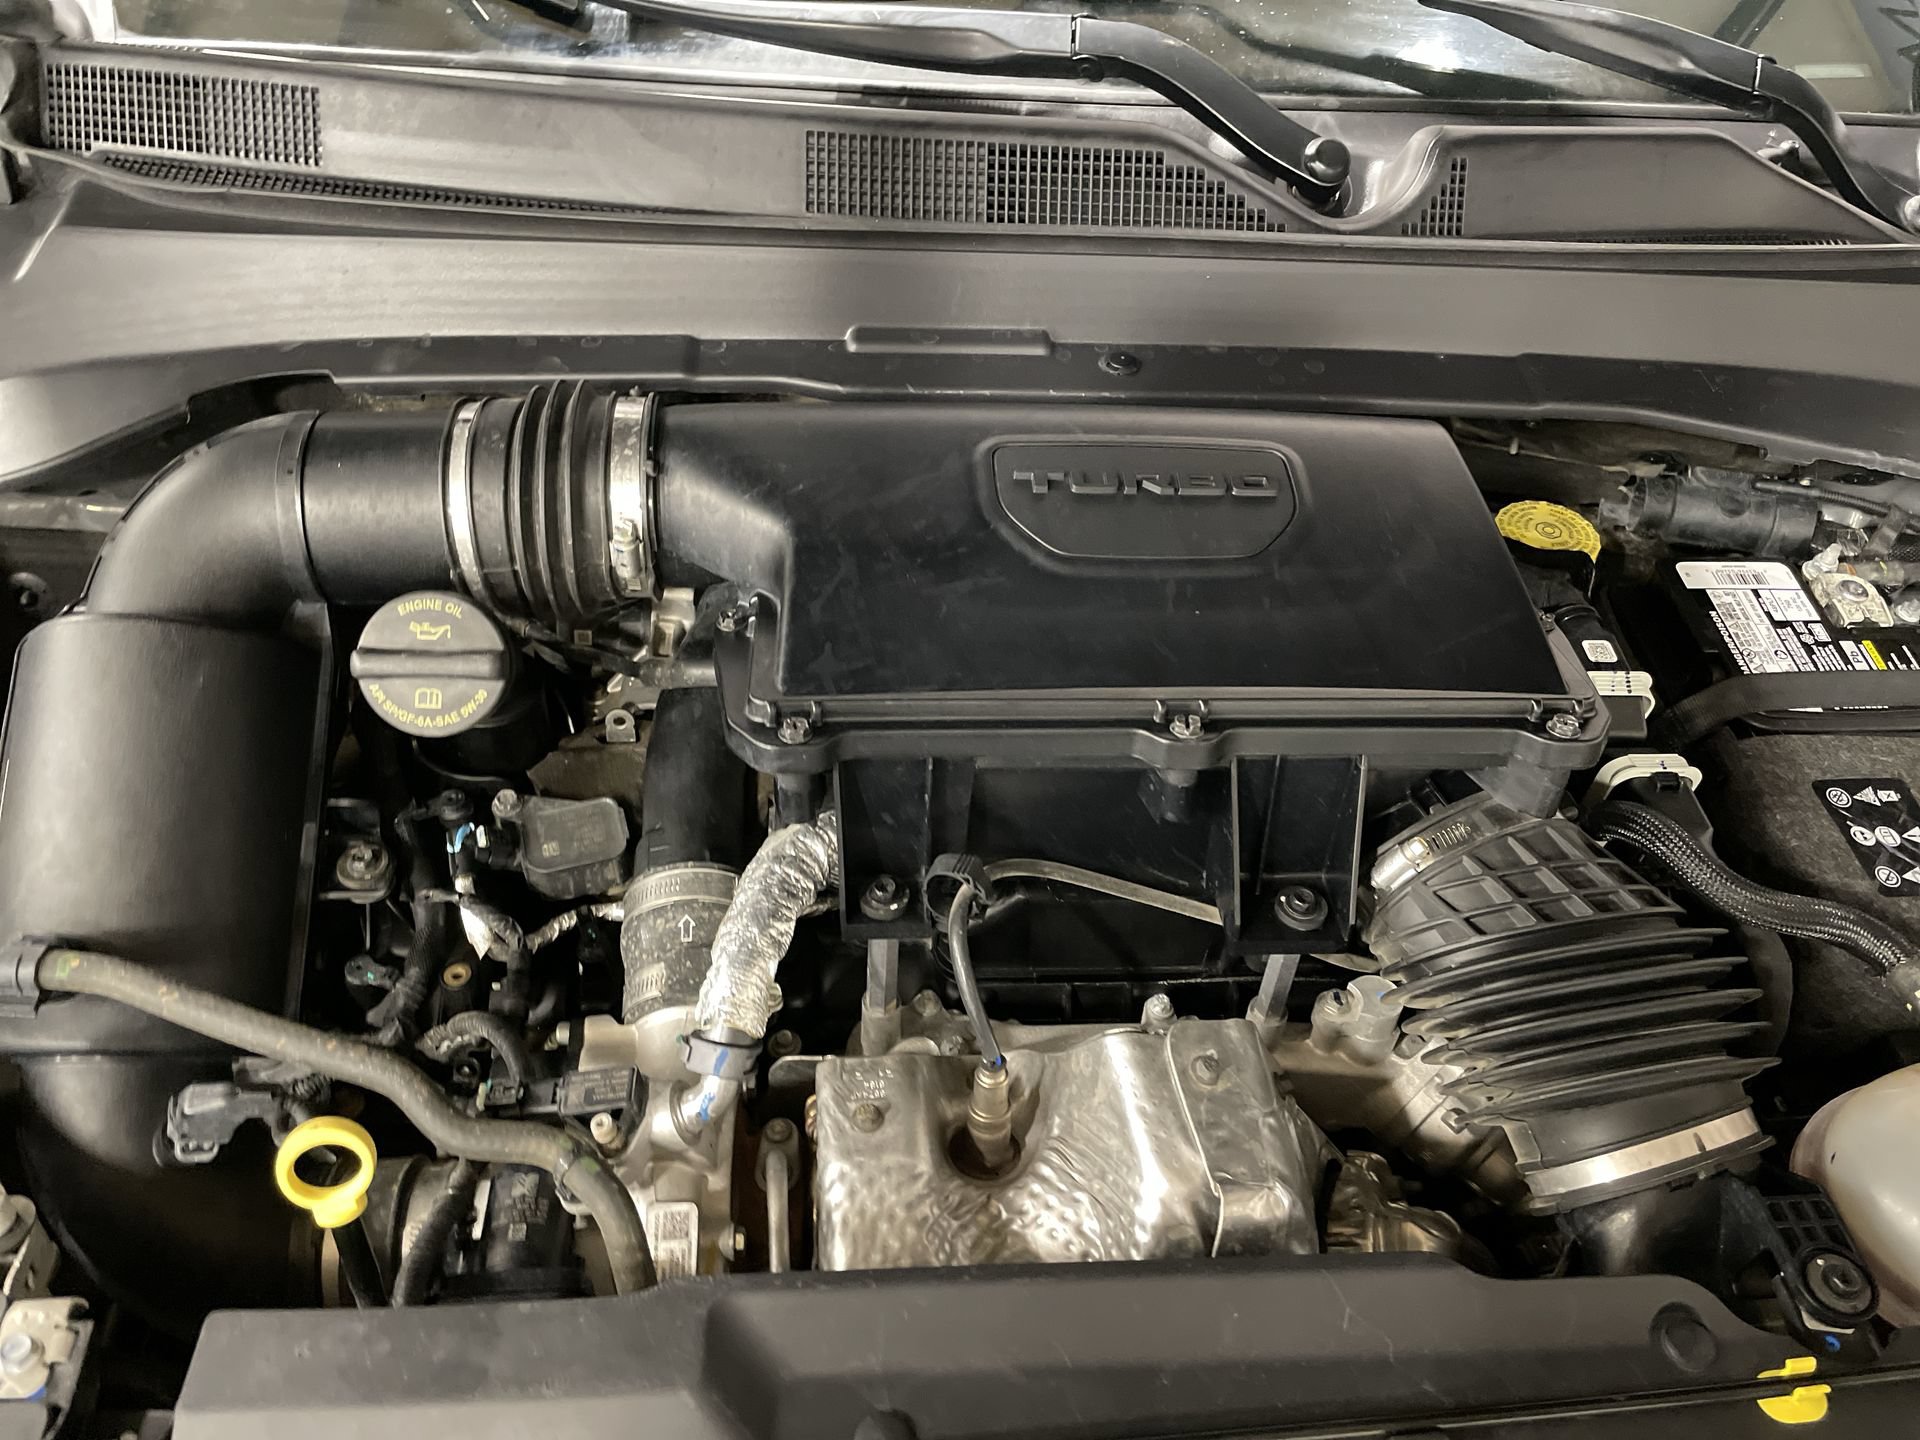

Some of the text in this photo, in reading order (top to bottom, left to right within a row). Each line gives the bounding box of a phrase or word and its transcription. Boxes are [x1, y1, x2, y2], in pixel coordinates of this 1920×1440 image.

[1013, 470, 1279, 496] TURBO
[397, 598, 462, 619] ENGINE OIL
[1849, 650, 1863, 664] Pb
